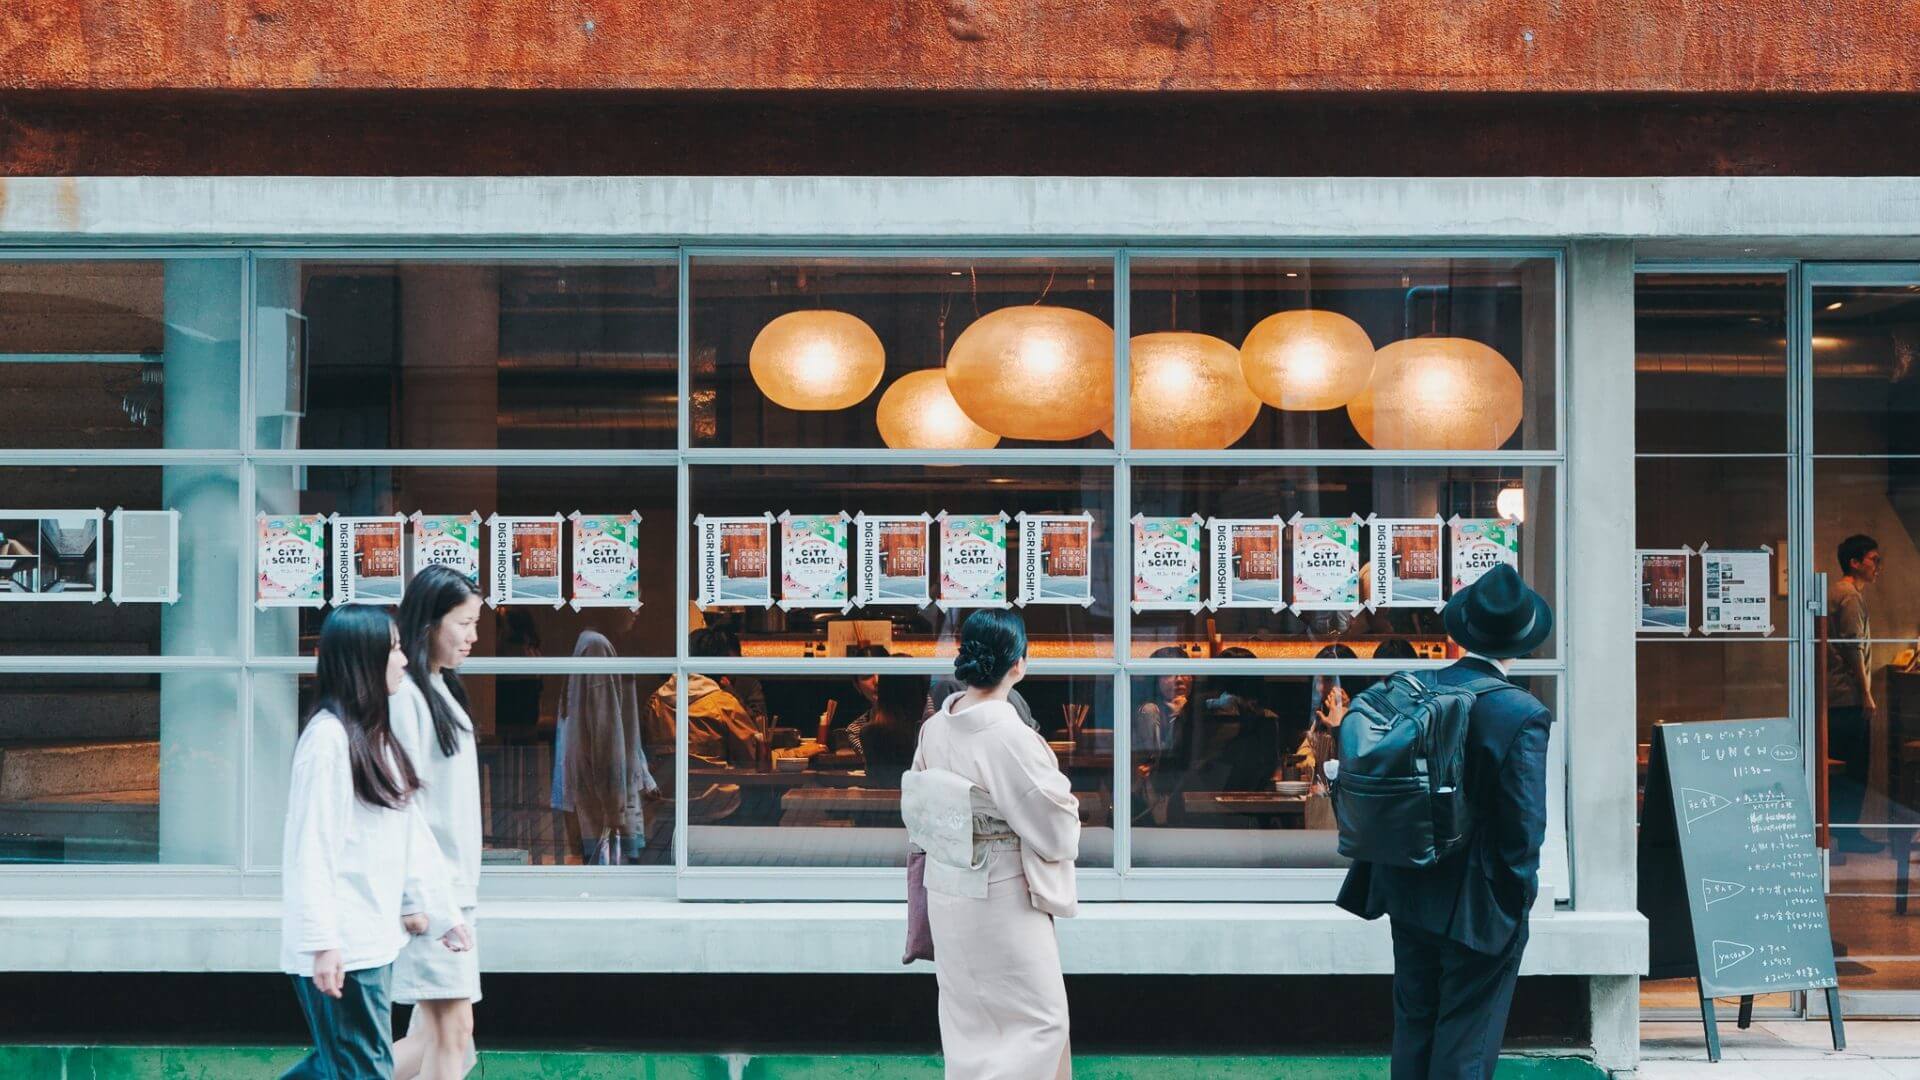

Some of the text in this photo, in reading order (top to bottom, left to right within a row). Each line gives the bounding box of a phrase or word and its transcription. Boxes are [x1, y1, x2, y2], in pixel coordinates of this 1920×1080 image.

[339, 523, 348, 548] DIG:R
[498, 523, 506, 548] DIG:R
[706, 523, 715, 548] DIG:R
[864, 522, 873, 547] DIG:R
[1026, 521, 1035, 546] DIG:R
[1217, 525, 1227, 550] DIG:R
[1377, 525, 1386, 550] DIG:R
[272, 556, 310, 564] SCAPE!
[427, 556, 465, 564] SCAPE!
[1148, 559, 1187, 567] SCAPE!
[1702, 746, 1767, 760] LUNCH
